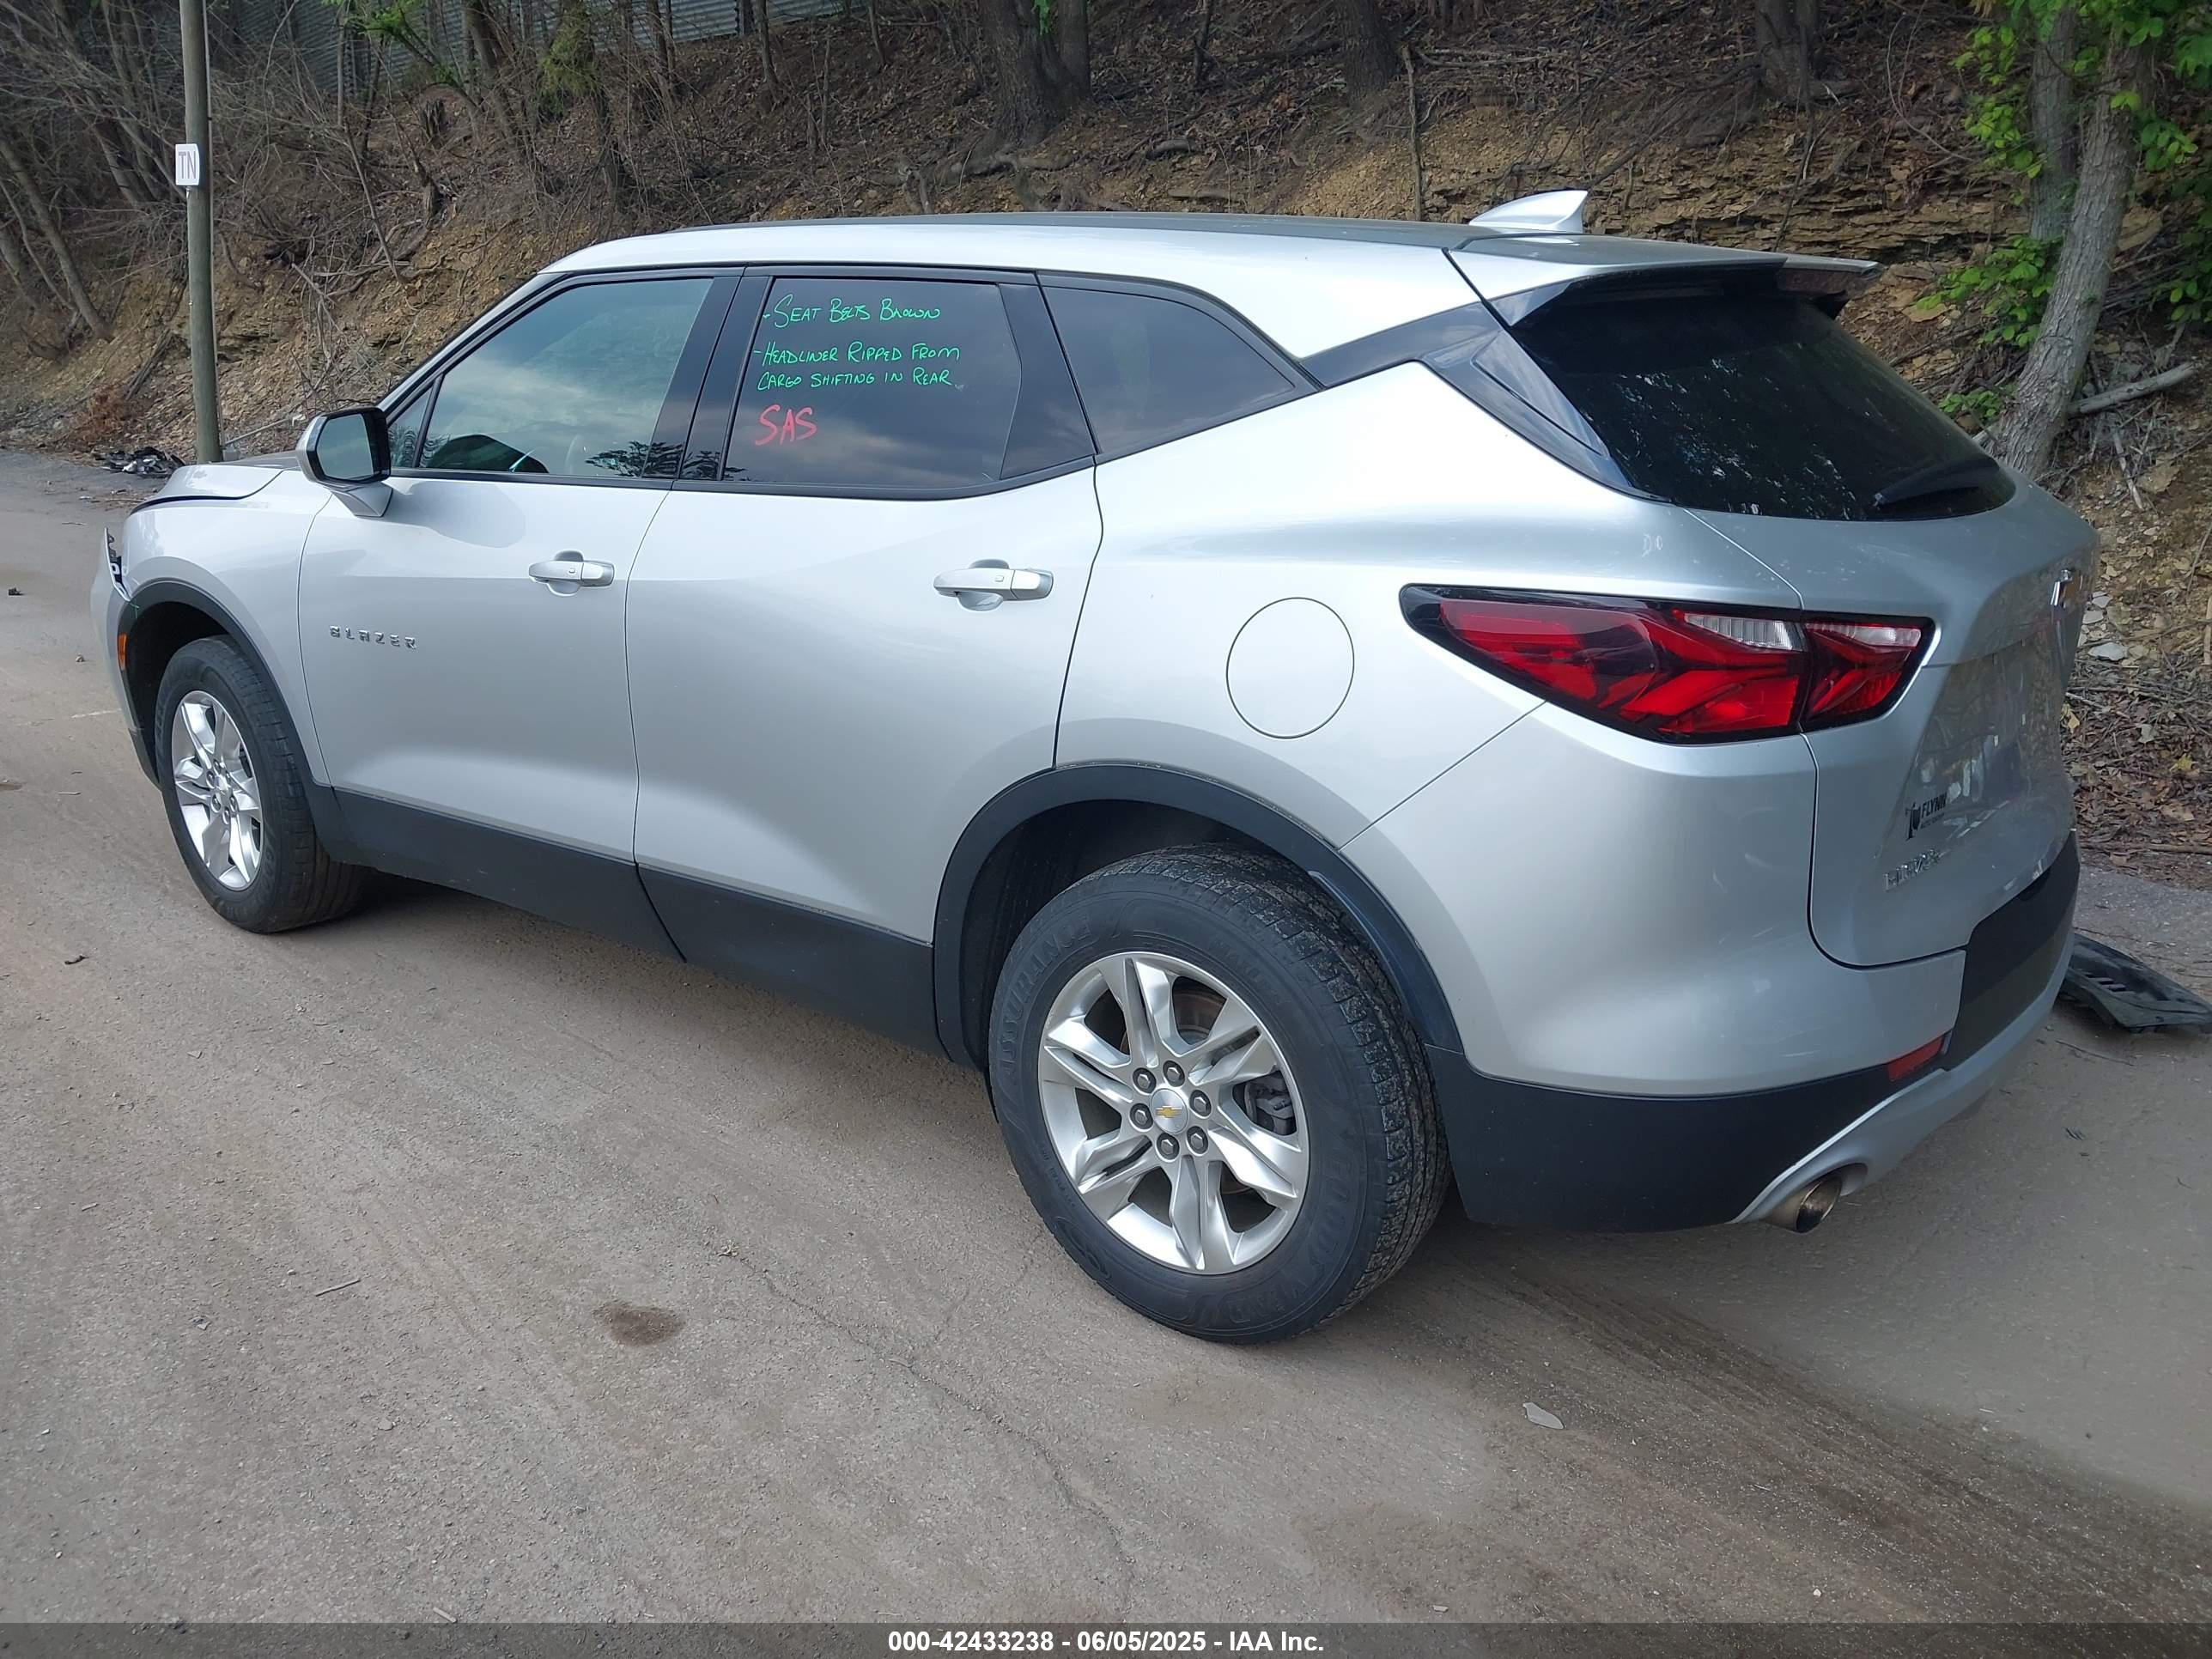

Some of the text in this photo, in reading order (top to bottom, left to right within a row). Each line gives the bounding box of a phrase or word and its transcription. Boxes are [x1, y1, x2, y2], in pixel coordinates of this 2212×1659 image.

[178, 150, 197, 179] TN
[847, 341, 902, 363] RIPPED
[757, 371, 802, 391] CARGO
[810, 373, 875, 386] SHIFTING
[884, 371, 903, 383] IN
[755, 404, 817, 447] SAS
[330, 625, 417, 650] BLAZER
